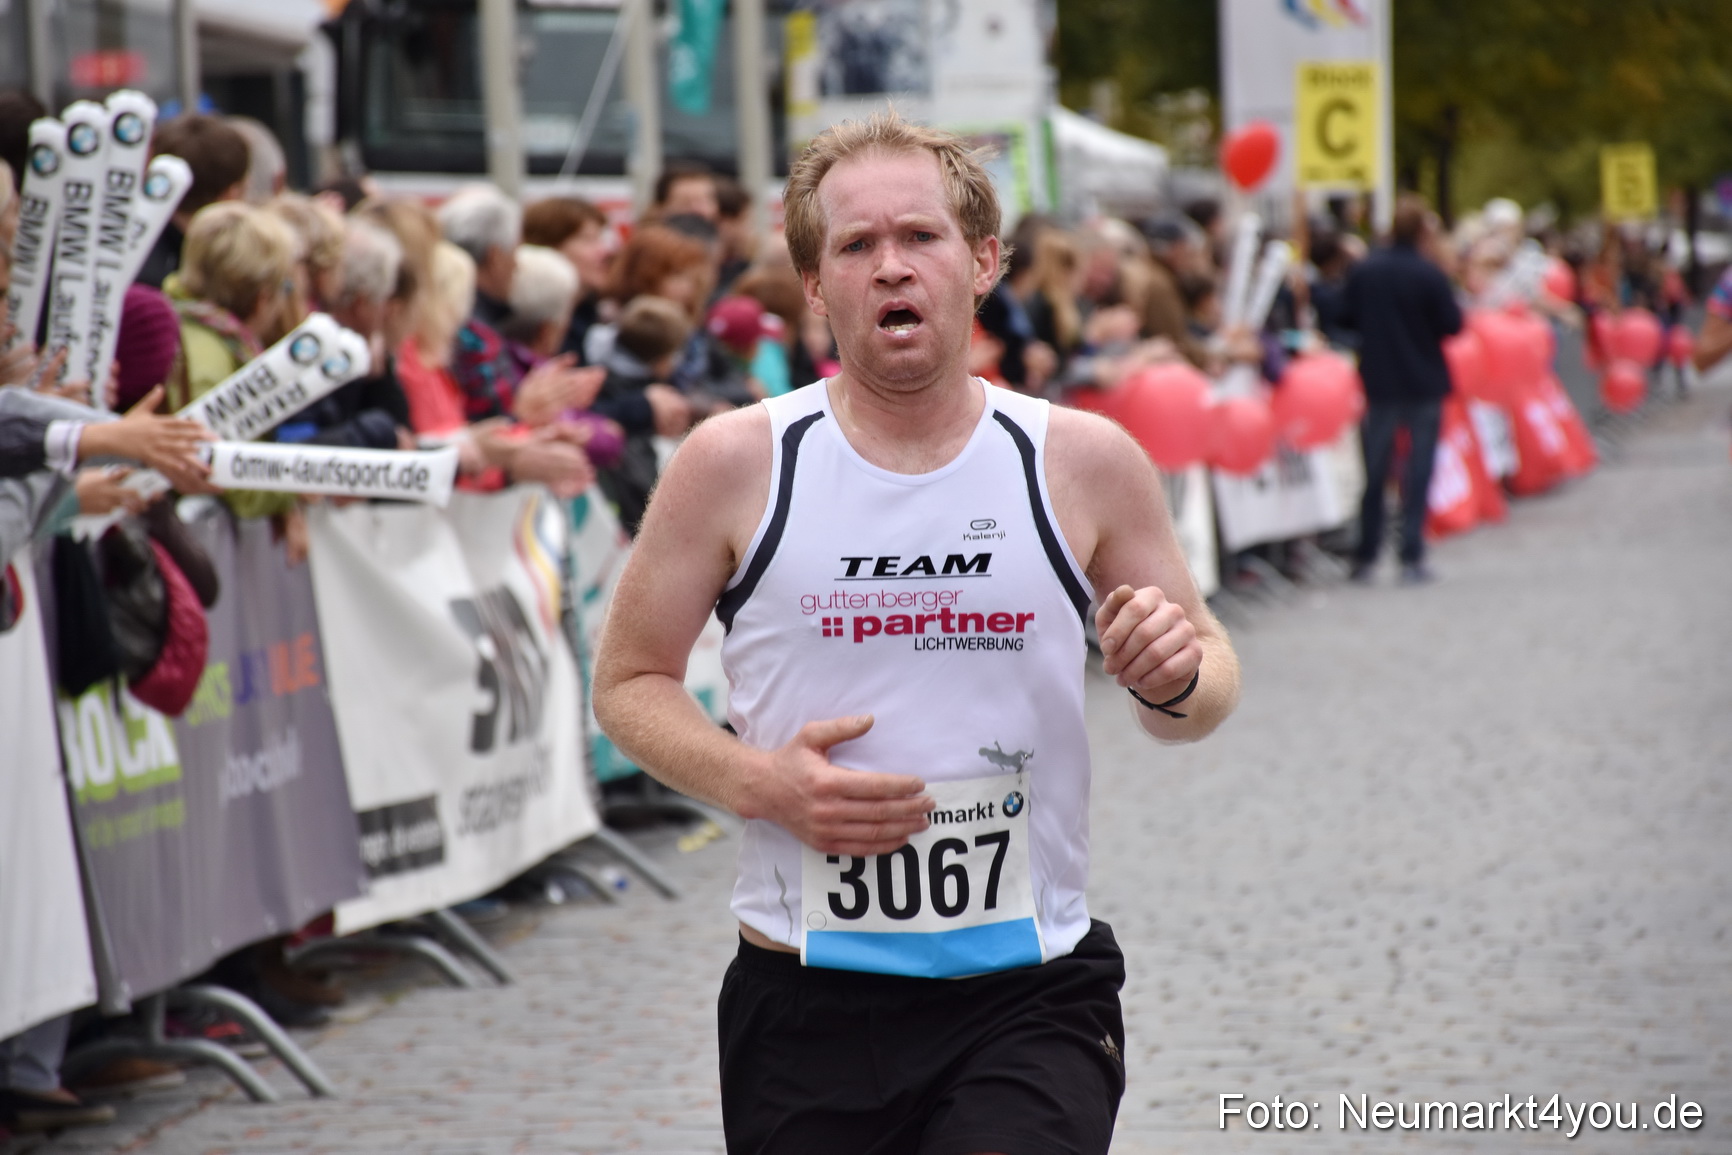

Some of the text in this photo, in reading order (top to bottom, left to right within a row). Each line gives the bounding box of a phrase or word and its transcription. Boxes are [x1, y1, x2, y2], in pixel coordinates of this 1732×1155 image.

[1315, 98, 1358, 160] C
[11, 196, 49, 273] BMW
[60, 181, 93, 266] BMW
[98, 168, 136, 251] BMW
[203, 363, 279, 429] BMW
[840, 552, 993, 578] TEAM
[962, 530, 1006, 542] Kalenji
[800, 588, 964, 616] guttenberger
[853, 607, 1035, 644] partner
[914, 636, 1025, 652] LICHTWERBUNG
[826, 829, 1011, 921] 3067
